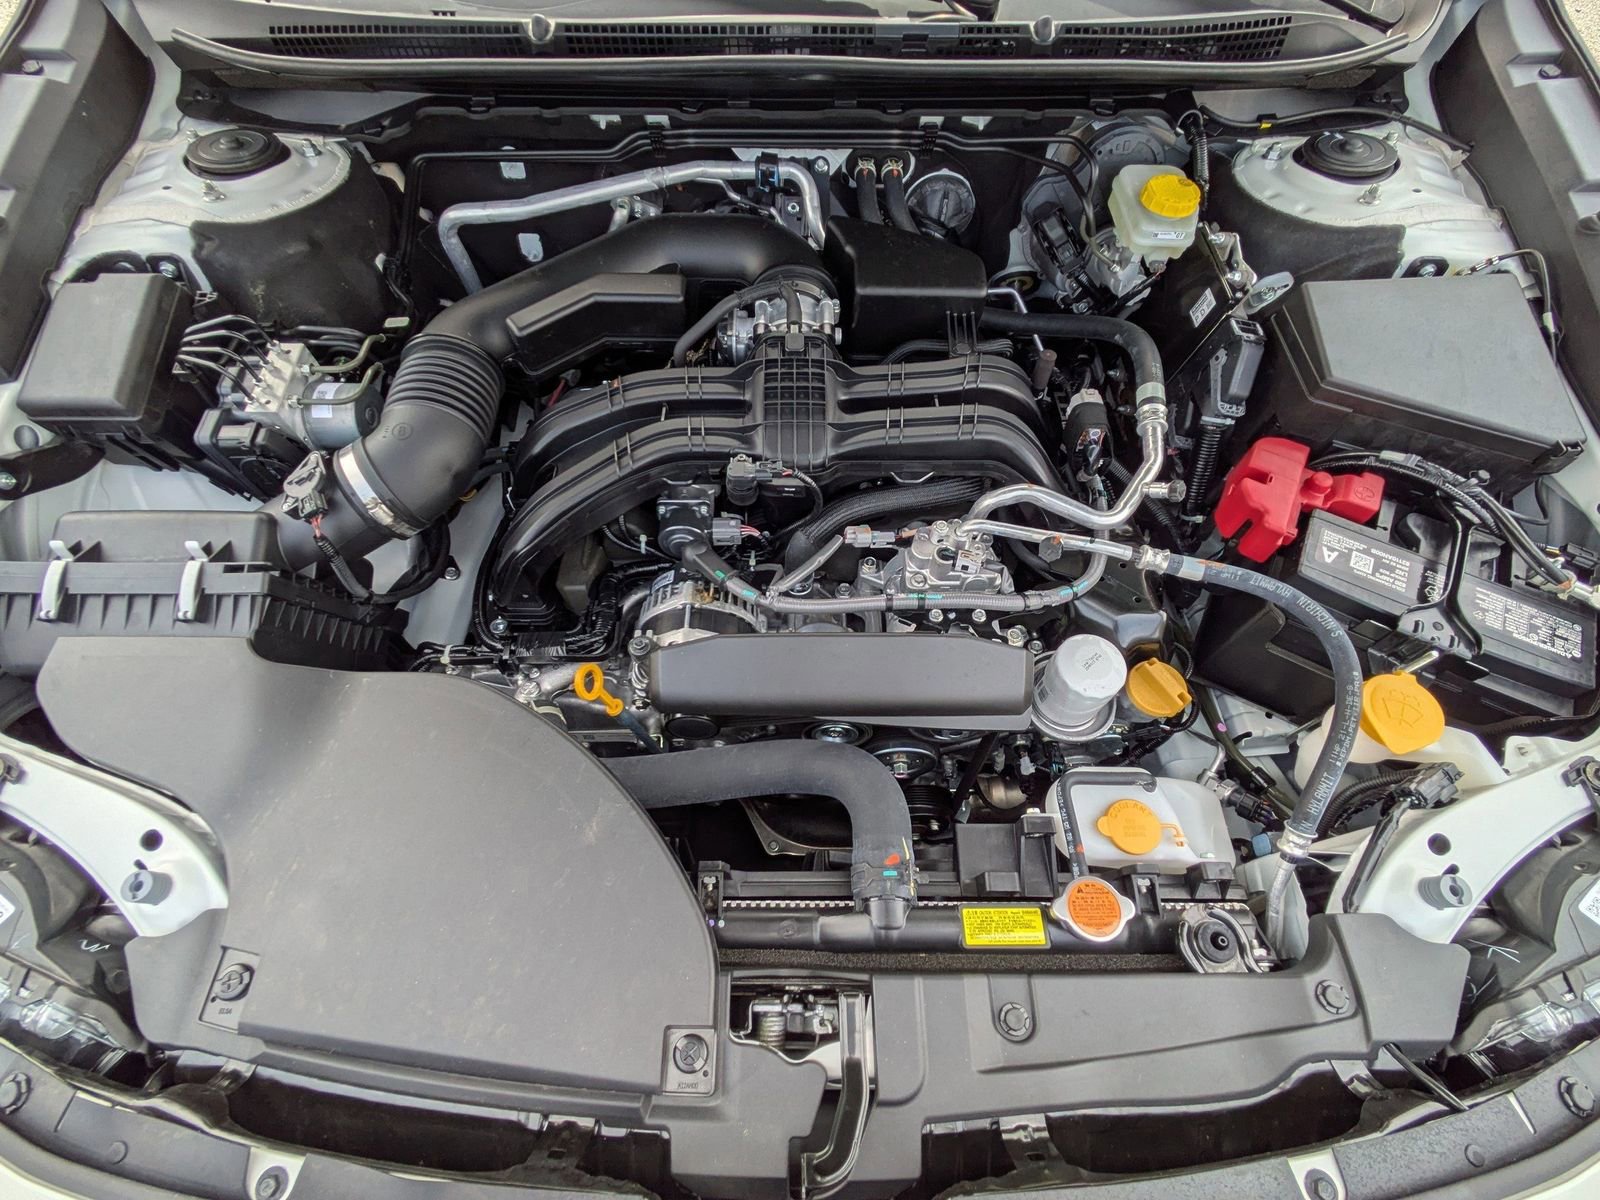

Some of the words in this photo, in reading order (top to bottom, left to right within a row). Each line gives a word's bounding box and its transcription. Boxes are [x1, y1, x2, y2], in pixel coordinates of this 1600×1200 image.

[1322, 546, 1339, 563] A
[1250, 574, 1293, 598] HYLAMMIT
[1375, 572, 1394, 583] AMPS
[1307, 771, 1334, 816] HYLAMMIT
